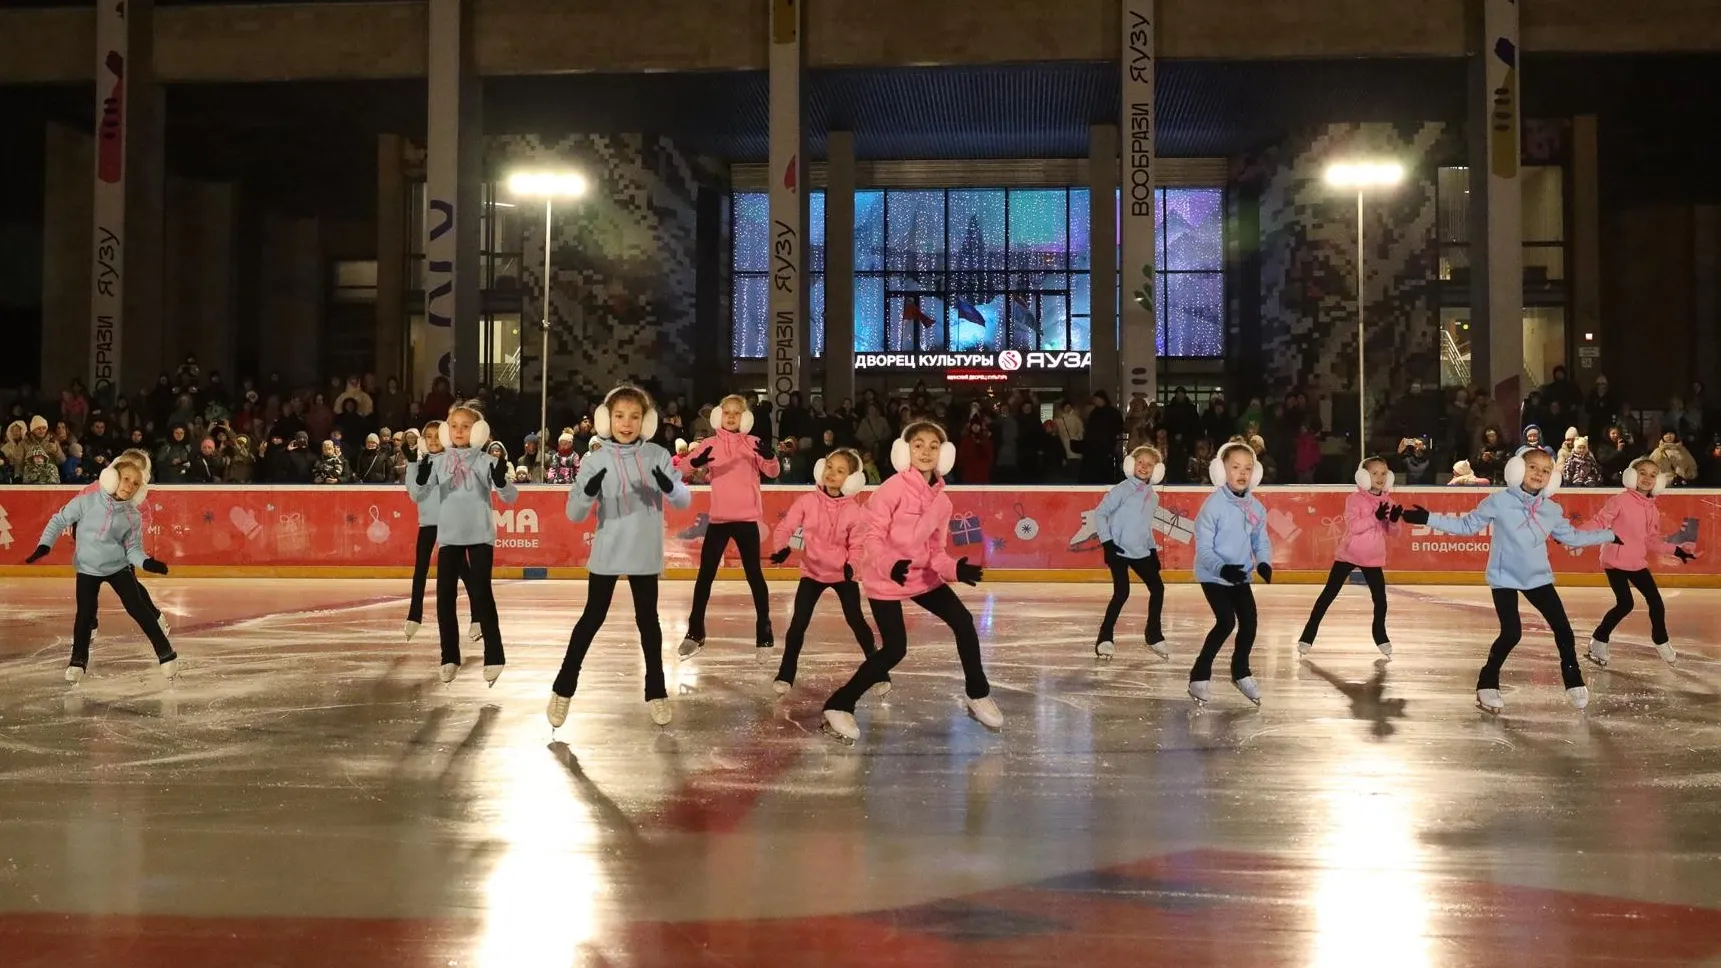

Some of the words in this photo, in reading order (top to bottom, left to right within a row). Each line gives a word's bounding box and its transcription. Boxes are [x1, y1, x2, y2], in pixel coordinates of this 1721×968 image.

[1131, 103, 1149, 216] ВООБРАЗИ
[95, 315, 114, 393] ОБРАЗИ
[855, 354, 915, 368] ДВОРЕЦ
[919, 354, 993, 367] КУЛЬТУРЫ
[1026, 352, 1091, 368] ЯУЗА
[490, 508, 539, 533] МА
[494, 538, 539, 548] СКОВЬЕ
[1412, 542, 1419, 551] В
[1422, 542, 1490, 552] ПОДМОСКО
